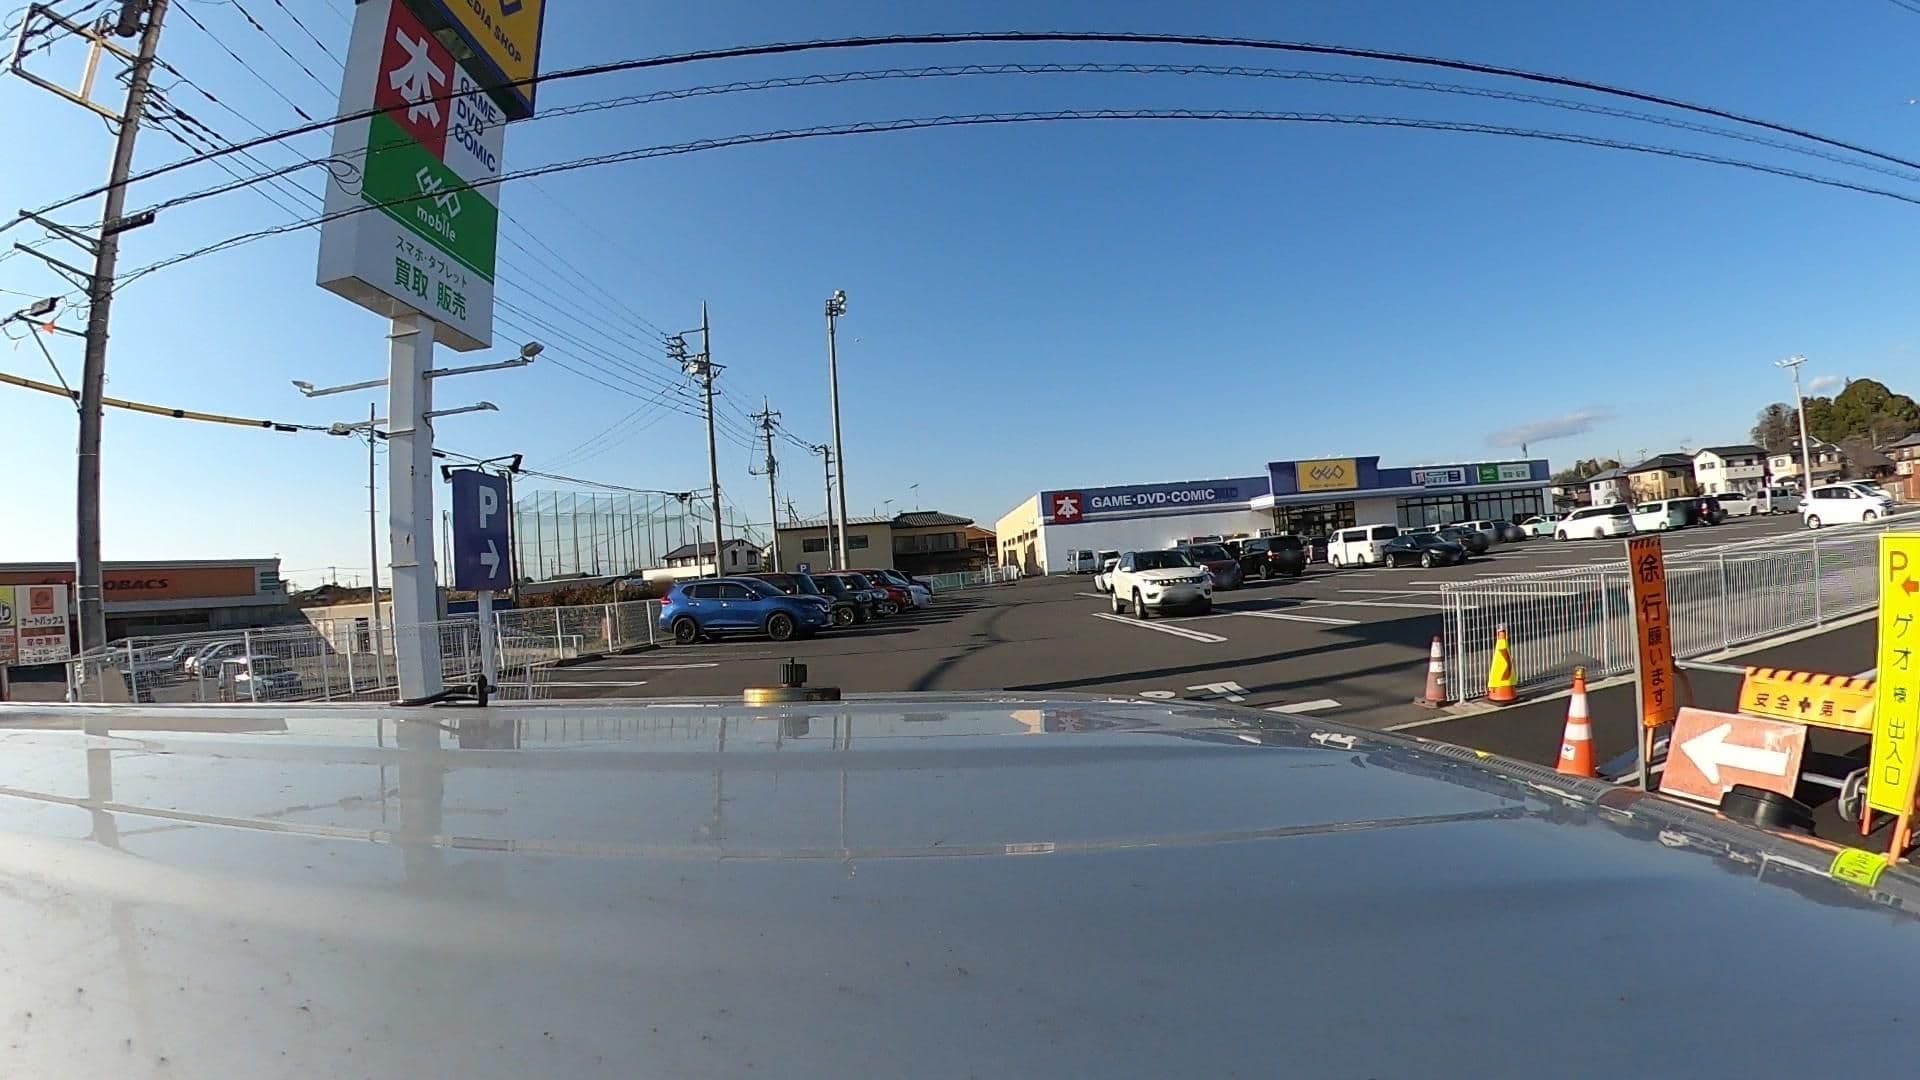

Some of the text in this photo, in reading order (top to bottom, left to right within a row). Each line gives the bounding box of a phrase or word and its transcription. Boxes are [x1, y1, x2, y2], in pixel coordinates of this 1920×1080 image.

[494, 25, 521, 62] SHOP
[389, 27, 446, 128] 本
[457, 99, 484, 136] DVD
[461, 77, 497, 124] GAME
[455, 123, 496, 172] COMIC
[416, 205, 456, 242] mobile
[395, 256, 466, 321] 買取 販売
[479, 485, 498, 529] P
[1056, 496, 1079, 519] 本
[1889, 550, 1909, 583] P
